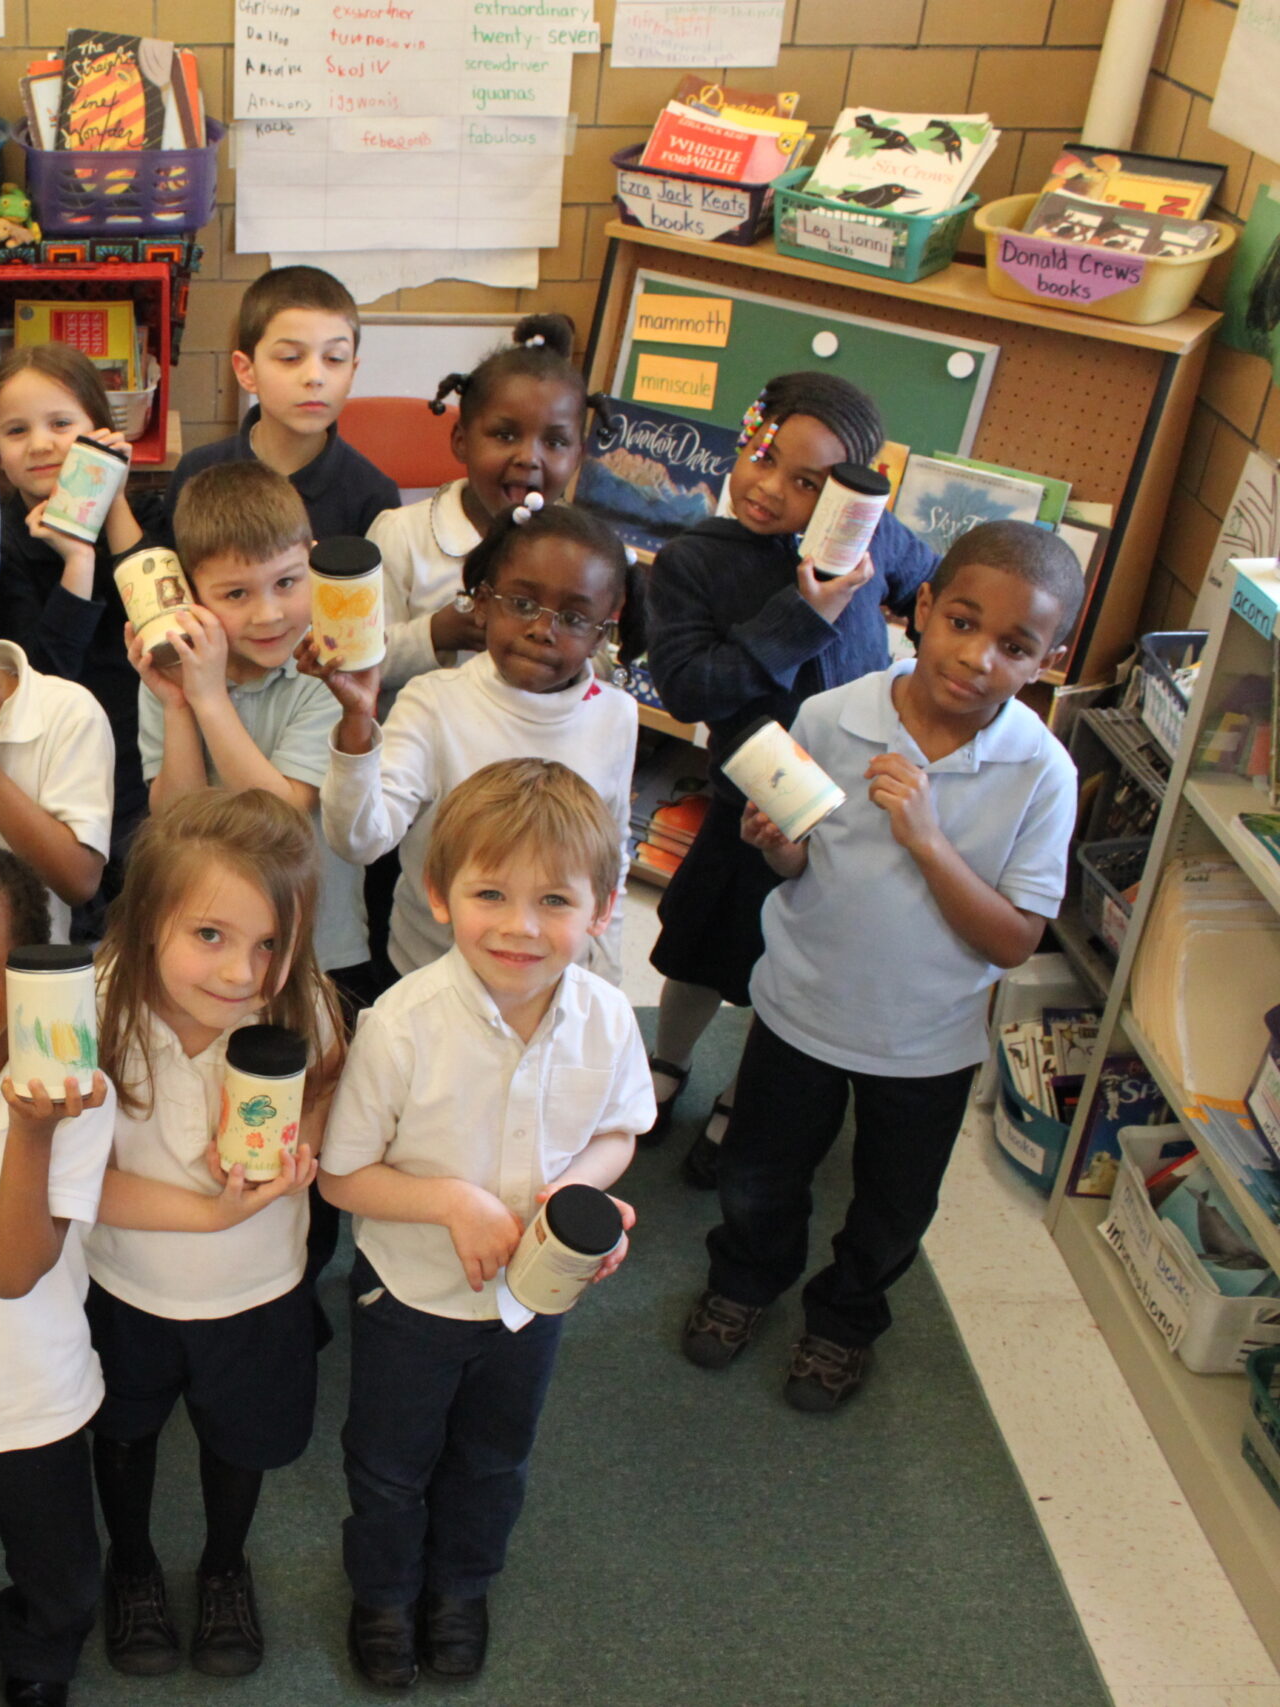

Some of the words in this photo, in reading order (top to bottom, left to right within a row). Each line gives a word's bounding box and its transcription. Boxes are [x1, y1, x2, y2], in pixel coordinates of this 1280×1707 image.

[474, 0, 590, 21] extraordinary
[78, 41, 104, 54] The
[67, 45, 136, 90] Straight
[465, 53, 549, 72] screwdriver
[472, 87, 536, 111] iguanas
[61, 118, 148, 150] Wonder
[468, 121, 537, 145] fabulous
[661, 150, 686, 167] FOR
[684, 153, 737, 176] WILLIE
[670, 134, 744, 165] WHISTLE
[872, 159, 899, 176] Six
[902, 162, 956, 185] Crows
[620, 173, 652, 197] Ezra
[657, 179, 693, 203] Jack
[701, 186, 747, 214] Keats
[651, 203, 705, 235] books
[802, 215, 831, 239] Leo
[839, 224, 889, 254] Lionni
[827, 240, 855, 257] books
[1001, 239, 1068, 271] Donald
[1078, 253, 1141, 284] Crews
[1037, 273, 1092, 300] books
[638, 310, 727, 335] mammoth
[640, 373, 712, 398] miniscule
[598, 414, 676, 460] Mountain
[668, 422, 730, 476] Dance
[920, 506, 961, 539] Sky
[1233, 590, 1270, 636] acorn
